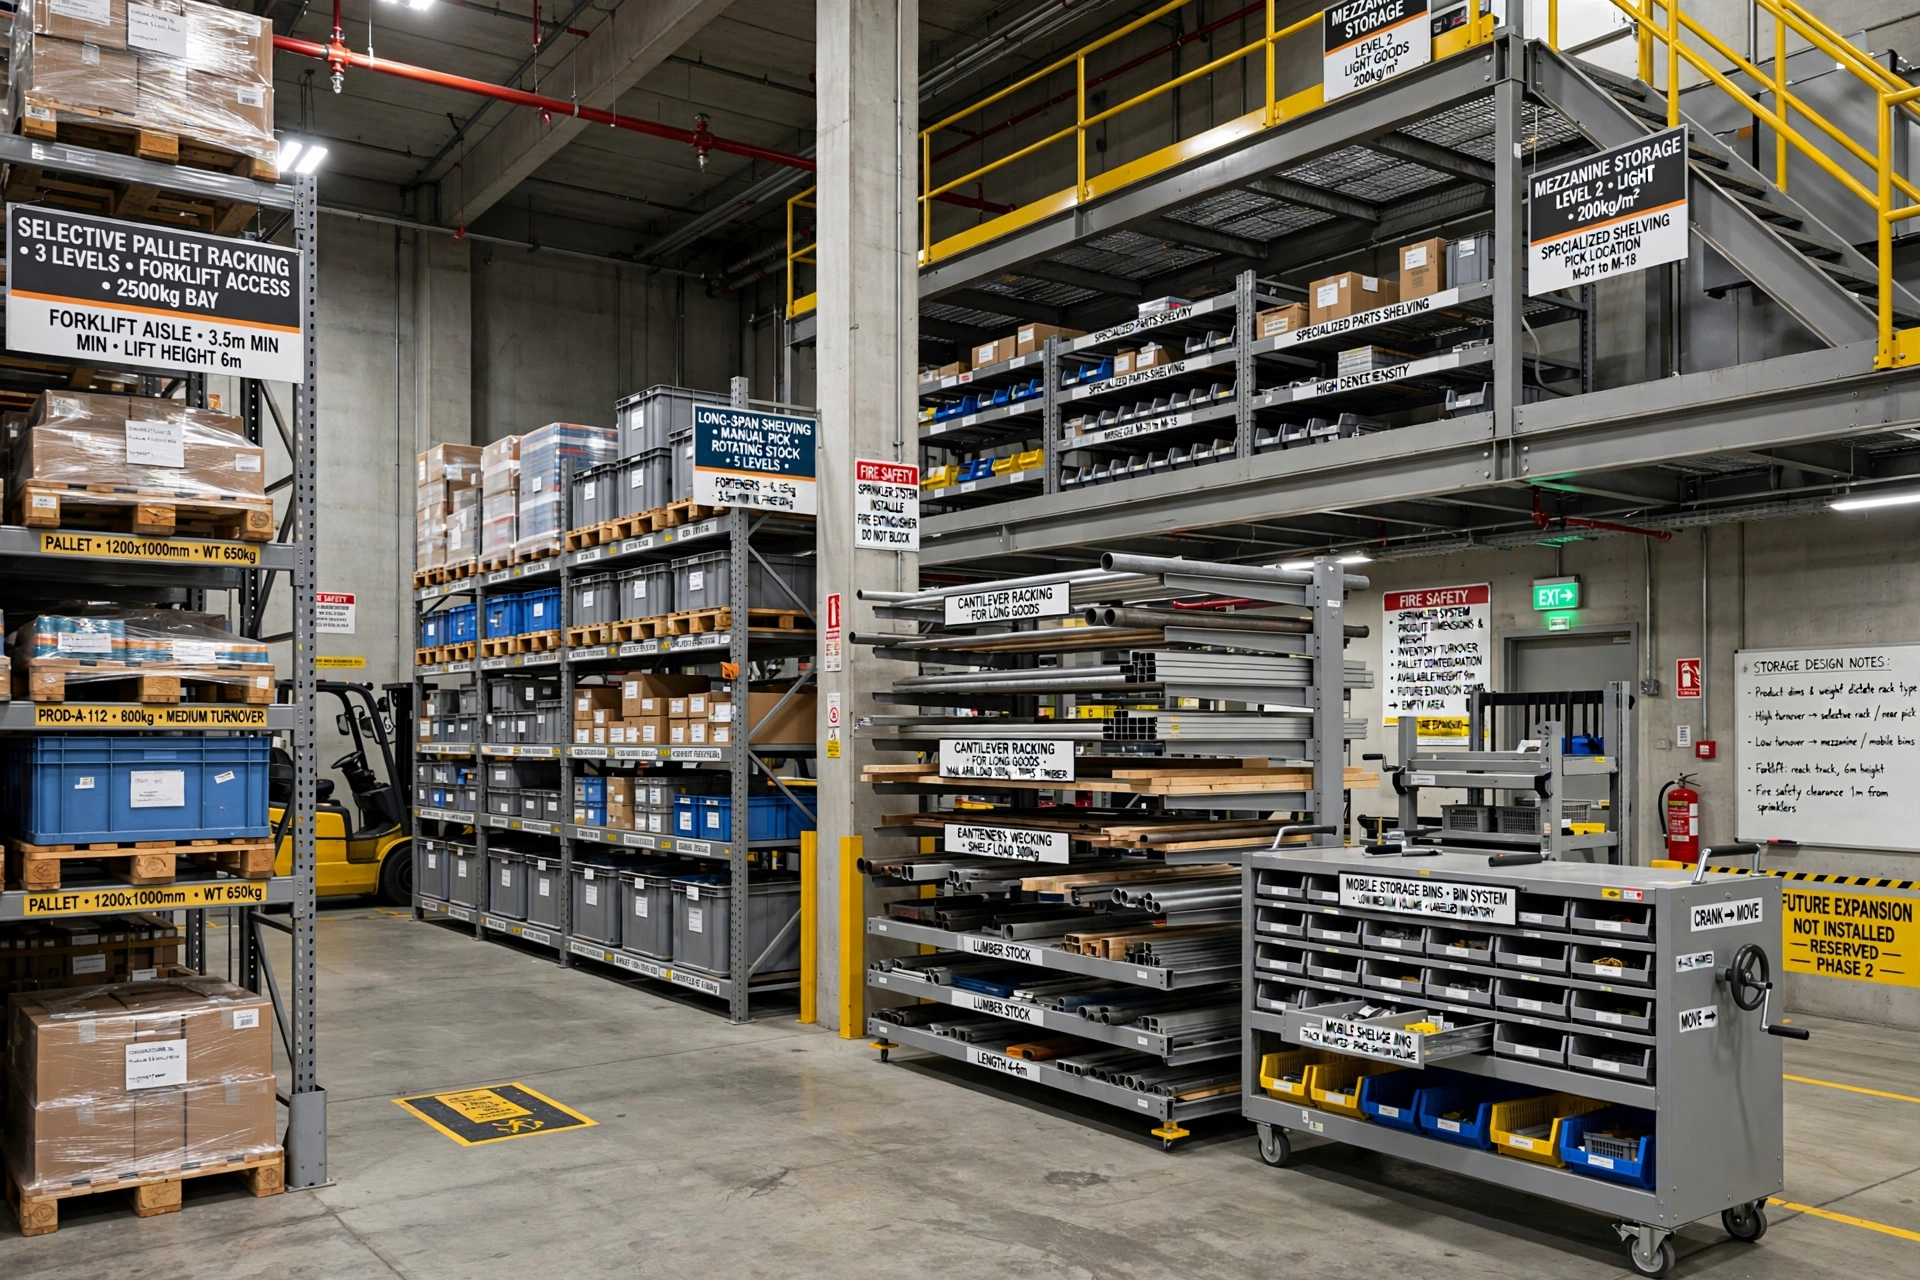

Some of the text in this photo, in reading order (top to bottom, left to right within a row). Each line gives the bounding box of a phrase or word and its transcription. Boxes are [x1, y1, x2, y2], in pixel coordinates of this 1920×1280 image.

[1345, 0, 1404, 38] STORAGE
[1355, 33, 1393, 58] LEVEL 2
[1344, 41, 1409, 76] LIGHT GOODS
[1535, 136, 1681, 198] MEZZANINE STORAGE
[1556, 165, 1655, 209] LEVEL 2 LIGHT
[1613, 214, 1670, 240] SHELVING
[18, 217, 290, 277] SELECTIVE PALLET RACKING
[1564, 236, 1641, 268] PICK LOCATION
[35, 243, 291, 298] 3 LEVELS FORKLIFT ACCESS
[1573, 253, 1637, 280] M-01 to M-18
[117, 278, 219, 309] 2500kg BAY
[1296, 298, 1429, 341] SPECIALIZED PARTS SHELVING
[50, 309, 279, 353] FORKLIFT AISLE 3.5m MIN
[77, 334, 242, 369] MIN LIFT HEIGHT 6m
[698, 411, 811, 436] LONG-SPAN SHELVING
[721, 427, 791, 446] MANUAL PICK
[711, 440, 800, 460] ROTATING STOCK
[734, 456, 780, 471] 5 LEVELS
[860, 465, 913, 483] FIRE SAFETY
[862, 529, 910, 543] DO NOT BLOCK
[45, 535, 256, 564] PALLET 1200x1000mm WT 650kg
[957, 587, 1053, 609] CANTILEVER RACKING
[1400, 589, 1468, 608] FIRE SAFETY
[971, 603, 1040, 620] FOR LONG GOODS
[1754, 660, 1799, 673] STORAGE
[1805, 658, 1844, 670] DESIGN
[1755, 687, 1783, 697] Product
[1819, 683, 1844, 699] weight
[1879, 682, 1894, 693] rack
[1900, 682, 1917, 697] type
[121, 710, 154, 726] 800kg
[166, 710, 208, 723] MEDIUM
[211, 710, 264, 724] TURNOVER
[1755, 710, 1772, 726] High
[1775, 710, 1805, 720] turnover
[1821, 708, 1851, 720] selective
[1855, 708, 1871, 718] rack
[1901, 707, 1916, 721] pick
[954, 741, 1055, 755] CANTILEVER RACKING
[1755, 737, 1771, 747] Low
[1775, 736, 1805, 746] turnover
[1869, 735, 1893, 746] mobile
[972, 756, 987, 766] FOR
[1792, 763, 1811, 774] reach
[1844, 763, 1856, 773] 6m
[1860, 763, 1884, 779] height
[1756, 784, 1771, 796] Fire
[1776, 783, 1801, 801] safety
[1851, 785, 1863, 797] 1m
[1868, 785, 1888, 797] from
[993, 844, 1014, 856] LOAD
[29, 885, 262, 912] PALLET 1200x1000mm WT 650kg
[1346, 877, 1507, 905] MOBILE STORAGE BINS BIN SYSTEM
[1694, 902, 1759, 927] CRANK MOVE
[1834, 897, 1912, 923] EXPANSION
[1794, 918, 1895, 943] NOT INSTALLED
[973, 939, 1031, 961] LUMBER STOCK
[1810, 939, 1879, 960] RESERVED
[1817, 957, 1874, 978] PHASE 2
[973, 997, 1030, 1021] LUMBER STOCK
[1681, 1010, 1702, 1030] MOVE
[977, 1051, 1006, 1071] LENGTH
